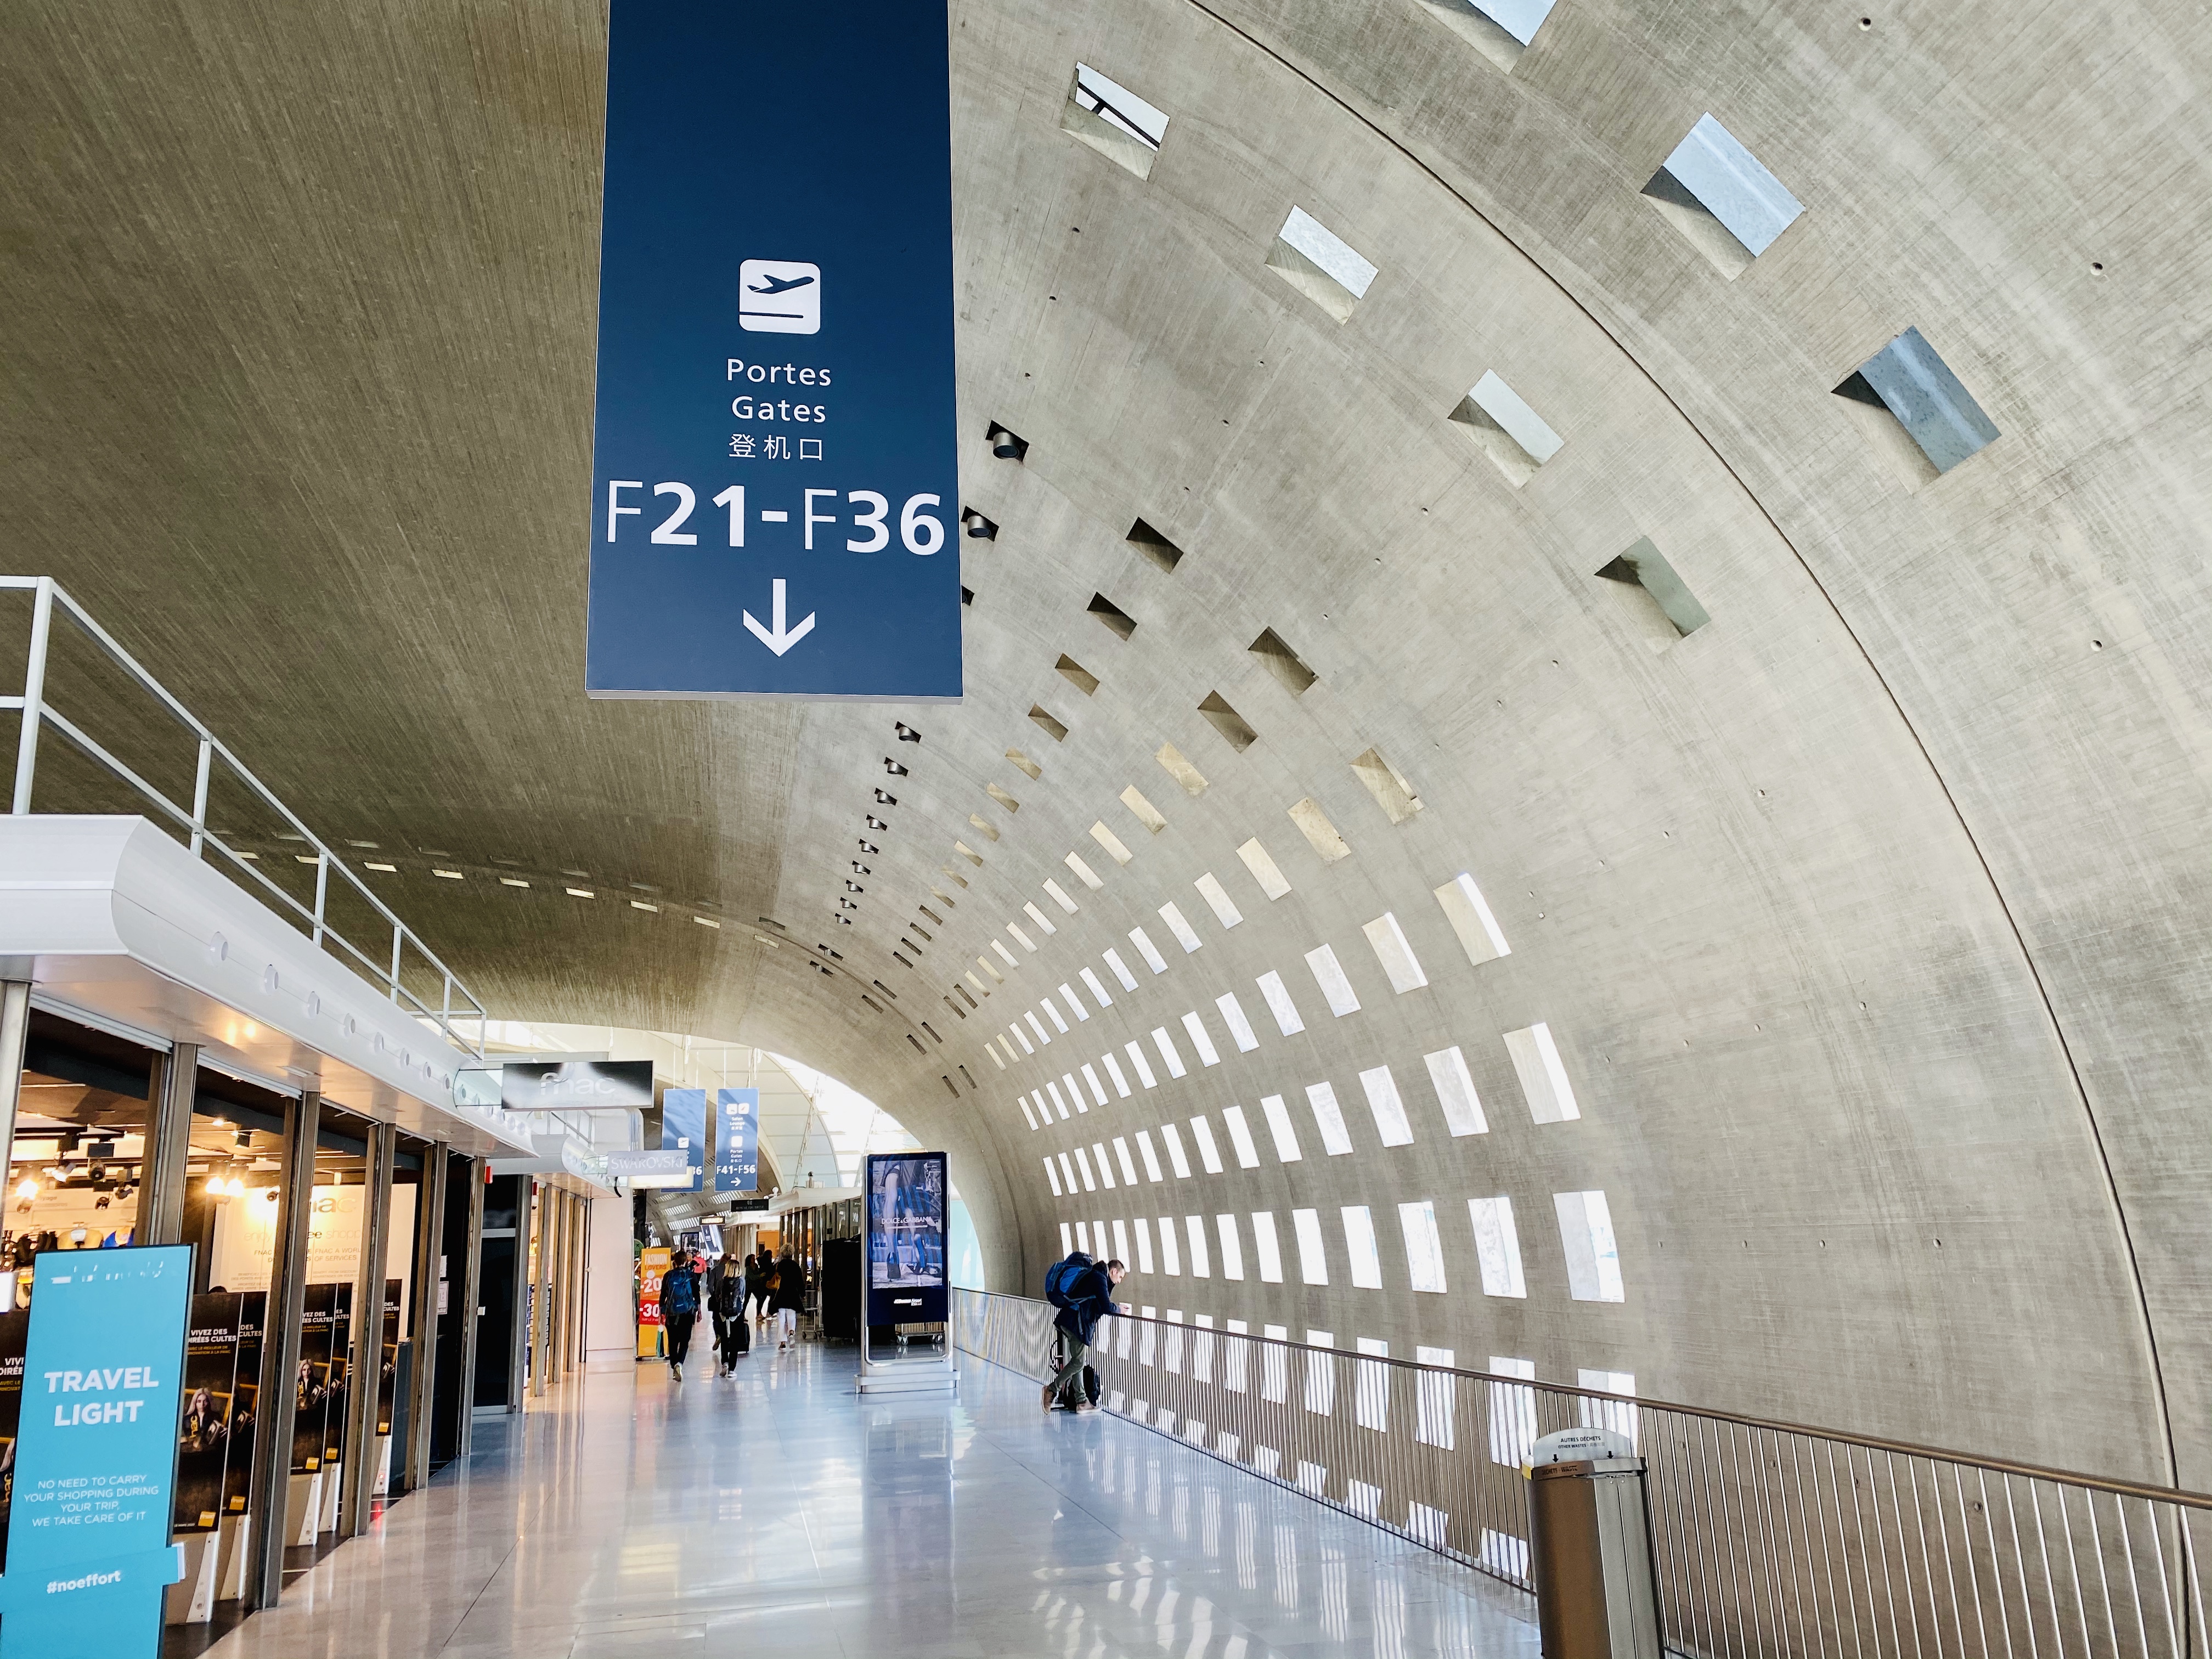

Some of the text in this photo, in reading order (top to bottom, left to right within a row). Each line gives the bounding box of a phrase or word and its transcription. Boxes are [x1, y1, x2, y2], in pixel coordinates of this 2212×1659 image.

[727, 358, 831, 386] Portes
[732, 396, 826, 424] Gates
[728, 433, 823, 461] 登机口
[607, 479, 945, 556] F21-F36
[540, 1072, 616, 1096] fnac
[611, 1156, 682, 1170] SWAROVSKI
[716, 1165, 756, 1175] F41-F56
[313, 1198, 356, 1213] ac
[326, 1228, 361, 1240] shopp
[645, 1254, 668, 1266] FASHION
[640, 1277, 663, 1293] -20
[44, 1366, 159, 1393] TRAVEL
[54, 1400, 144, 1426] LIGHT
[38, 1474, 147, 1490] NO NEED TO CARRY
[24, 1486, 159, 1503] YOUR SHOPPING DURING
[61, 1502, 91, 1513] YOUR
[32, 1510, 146, 1527] WE TAKE CARE OF IT
[47, 1570, 122, 1594] #noeffort
